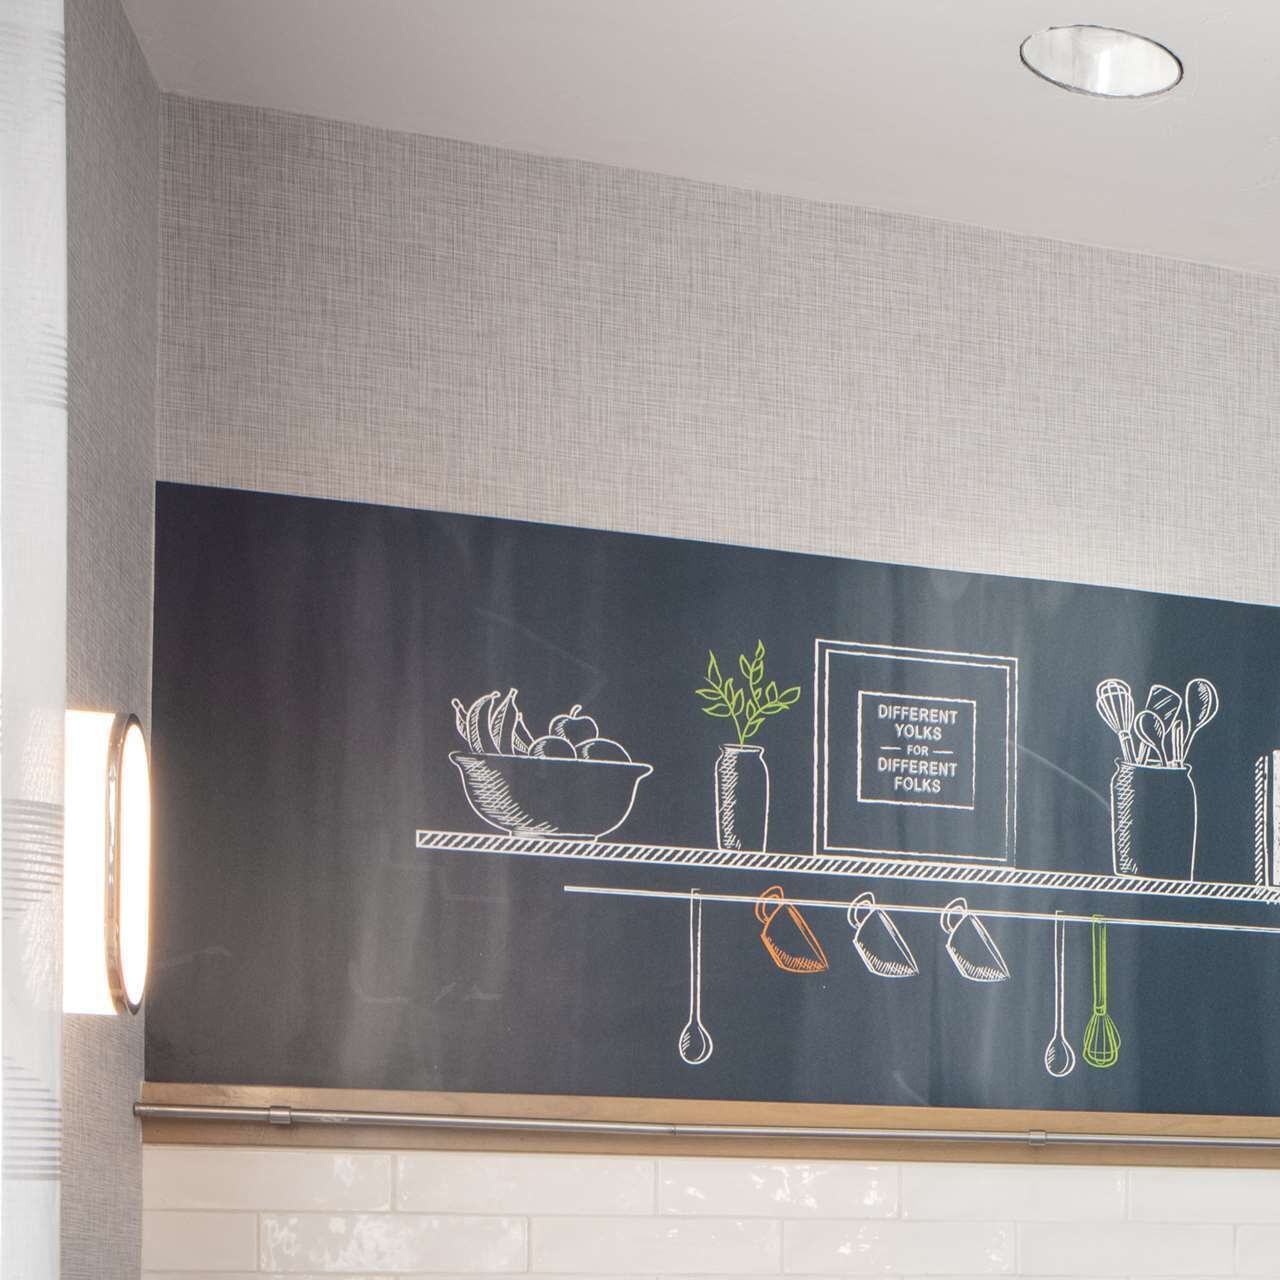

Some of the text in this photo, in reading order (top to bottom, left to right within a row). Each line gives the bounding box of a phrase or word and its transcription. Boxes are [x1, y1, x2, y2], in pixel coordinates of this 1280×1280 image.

[878, 704, 958, 724] DIFFERENT
[895, 723, 942, 740] YOLKS
[907, 745, 929, 756] FOR
[877, 757, 958, 777] DIFFERENT
[894, 777, 941, 793] FOLKS
